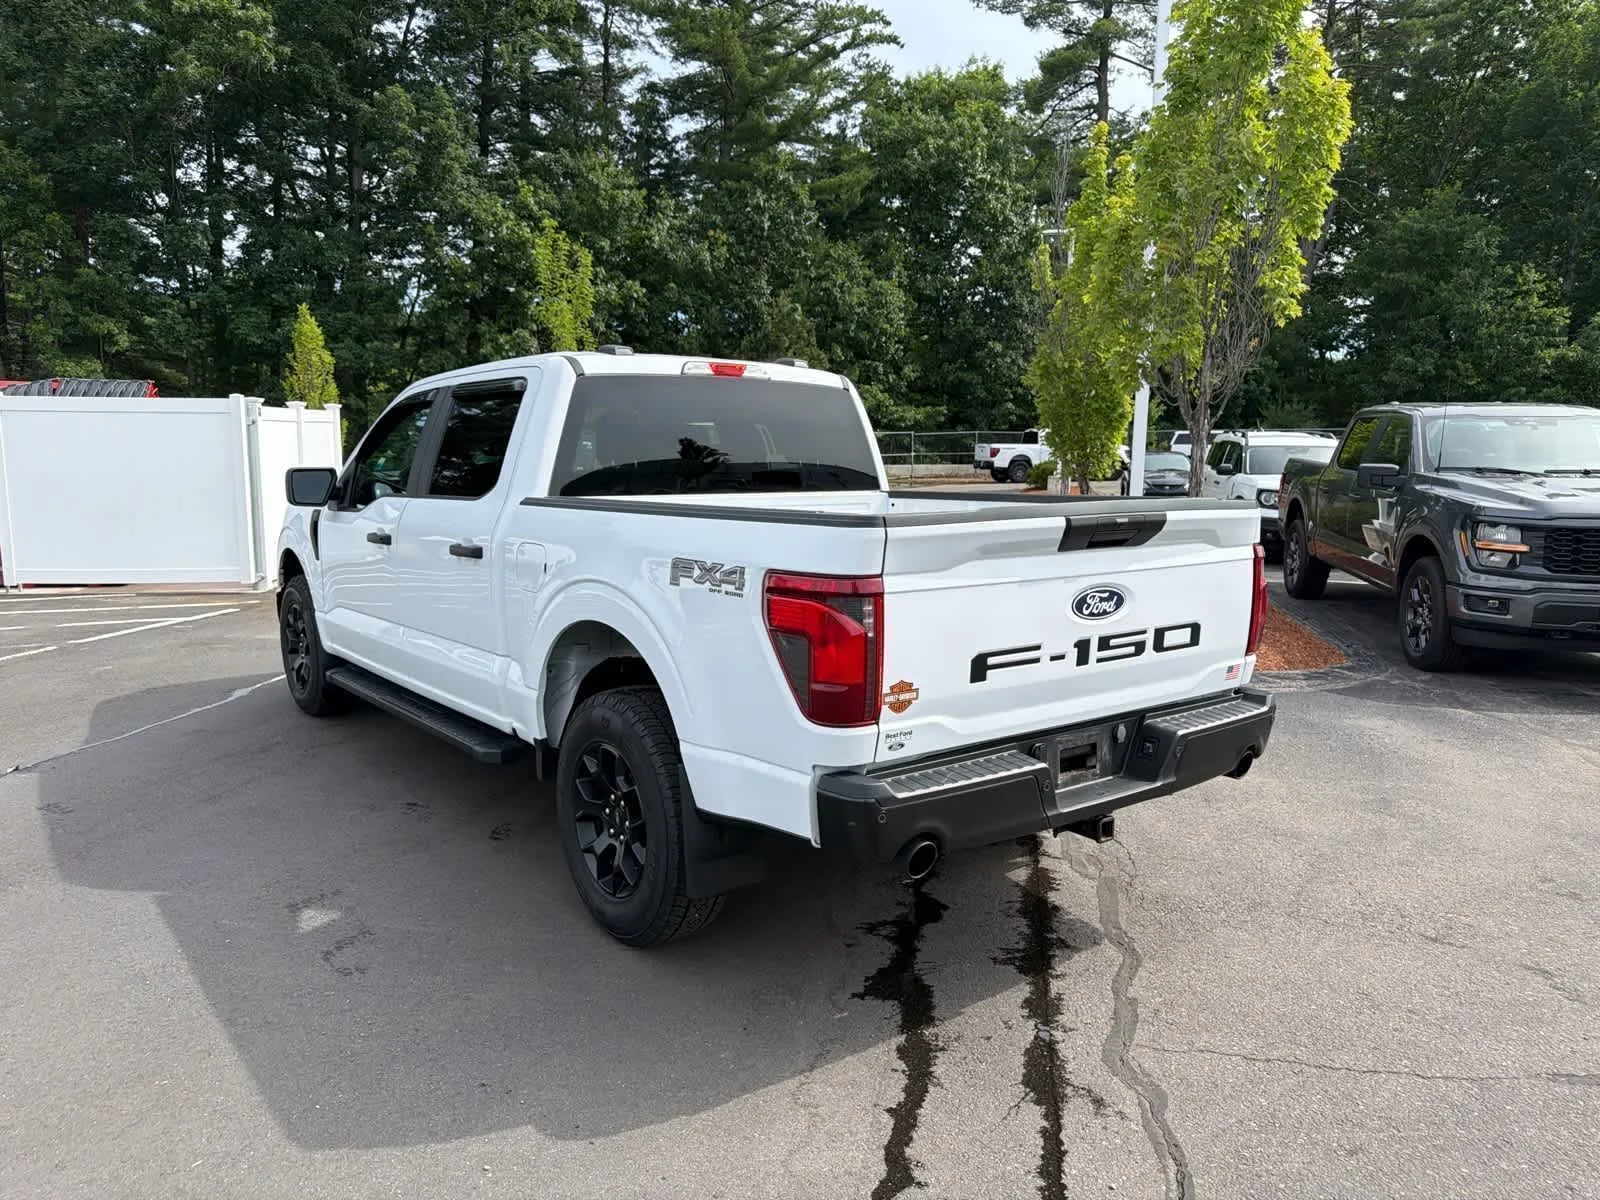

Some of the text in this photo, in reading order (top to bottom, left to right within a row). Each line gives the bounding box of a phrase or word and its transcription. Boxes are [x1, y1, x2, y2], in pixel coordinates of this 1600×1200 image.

[669, 557, 746, 591] FX4
[1082, 592, 1118, 615] Ford
[969, 622, 1201, 684] F-150
